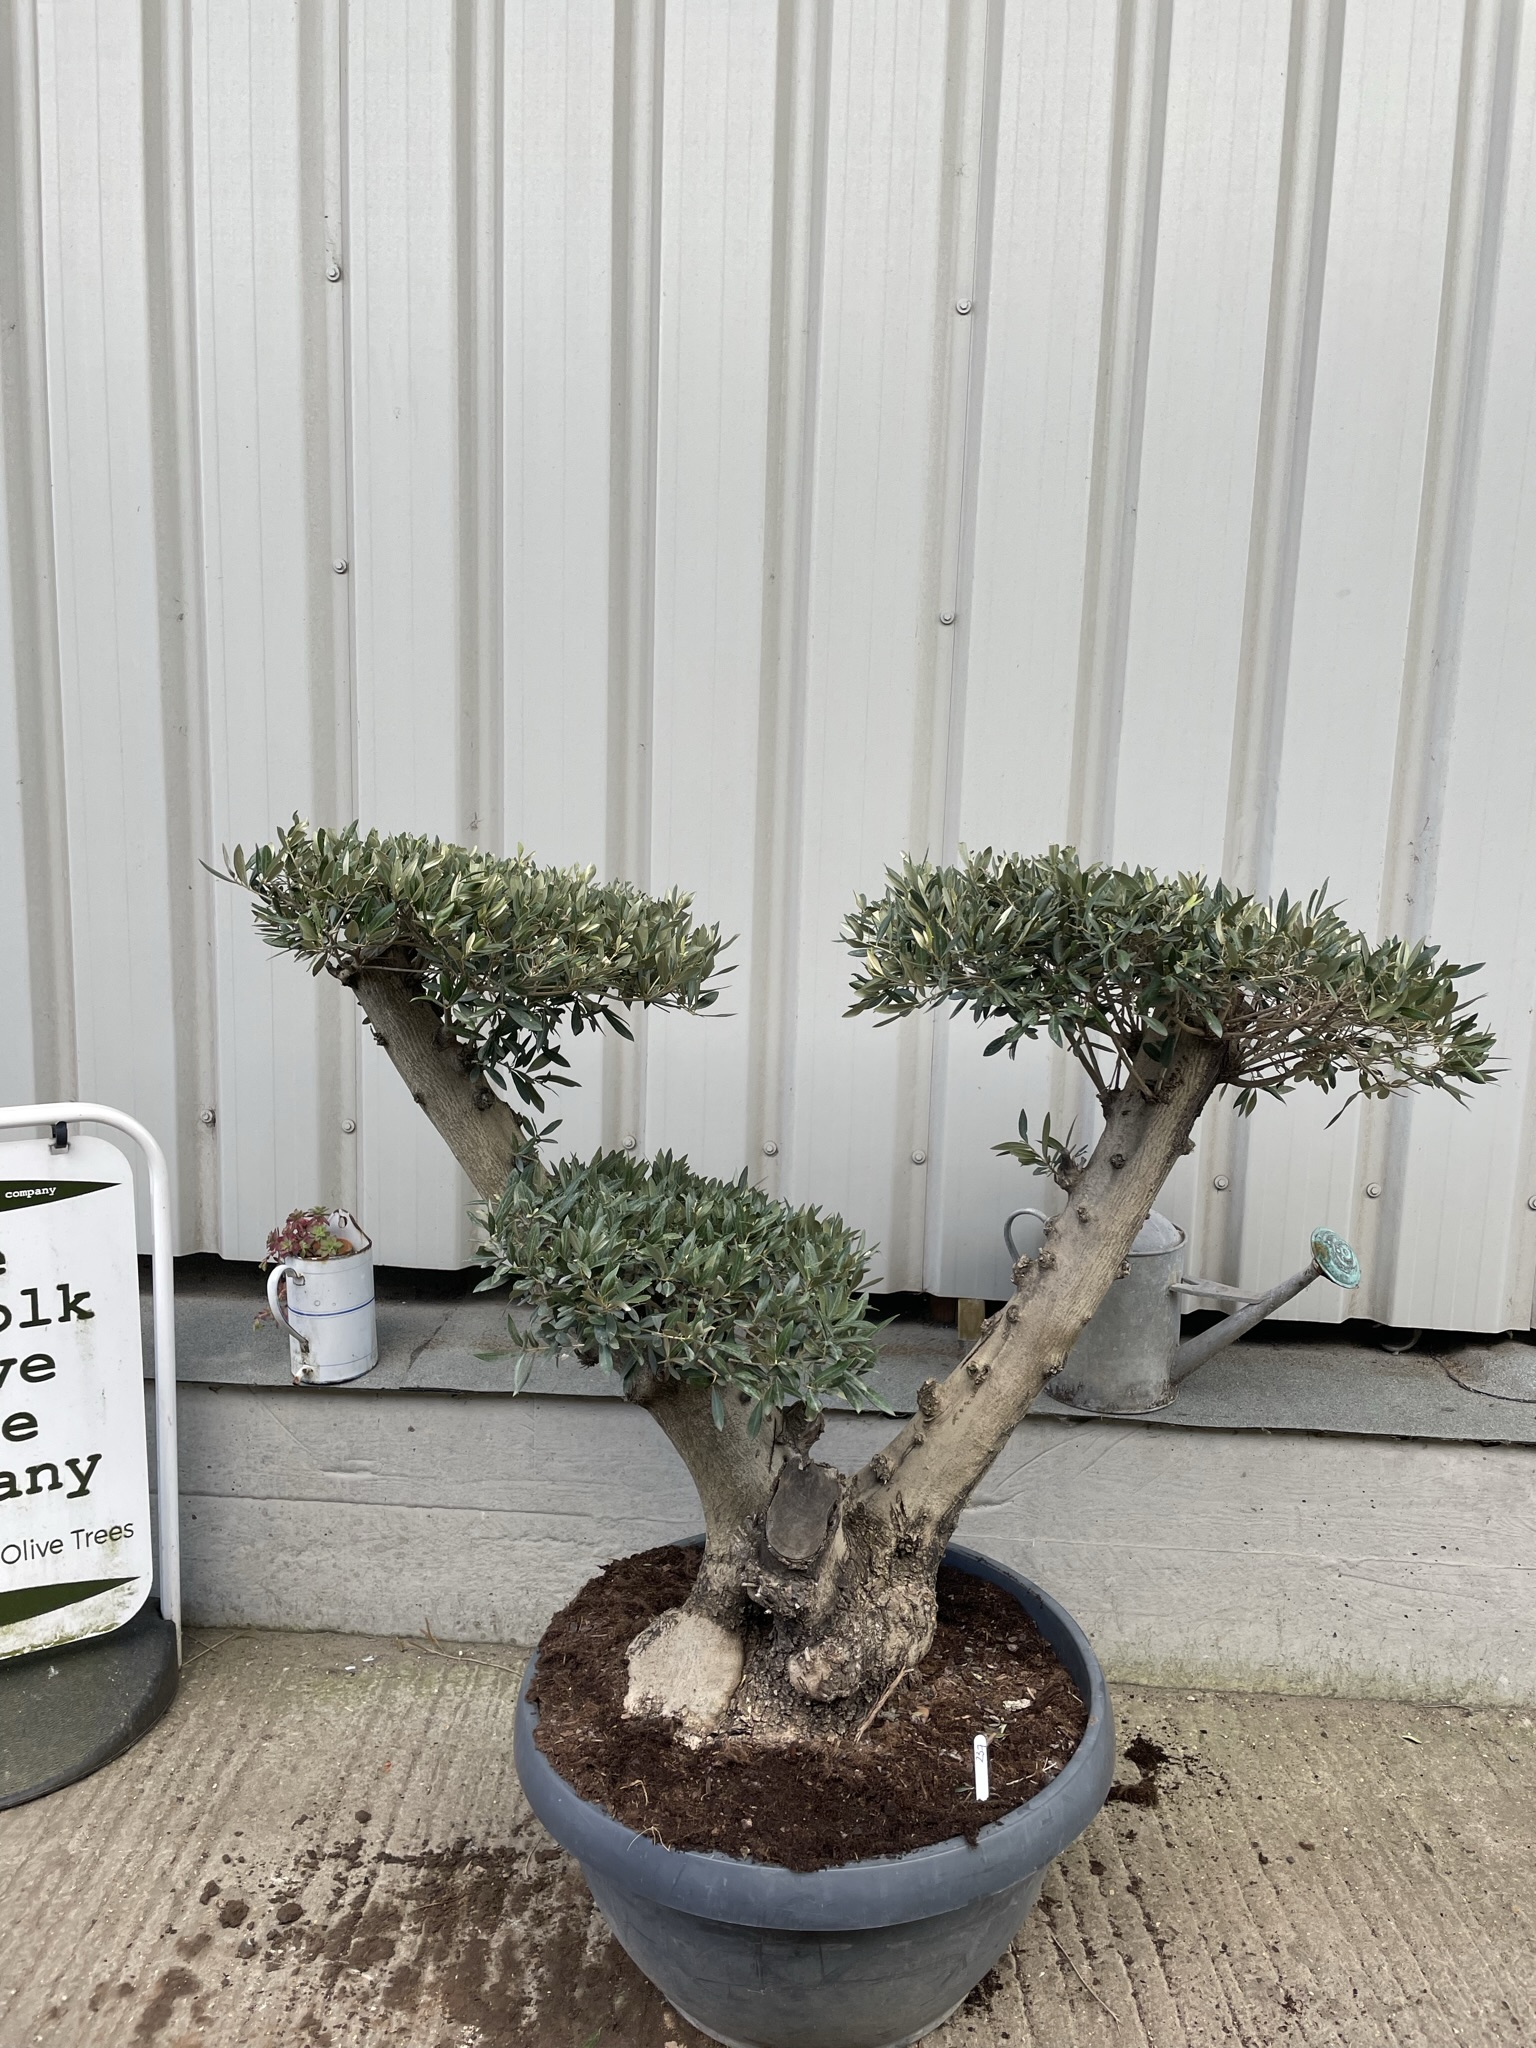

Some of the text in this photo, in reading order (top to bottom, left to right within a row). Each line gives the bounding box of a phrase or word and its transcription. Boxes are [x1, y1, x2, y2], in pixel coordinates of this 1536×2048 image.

[5, 1186, 57, 1199] company
[2, 1411, 38, 1442] e
[0, 1453, 102, 1500] any
[1, 1522, 134, 1564] Olive Trees
